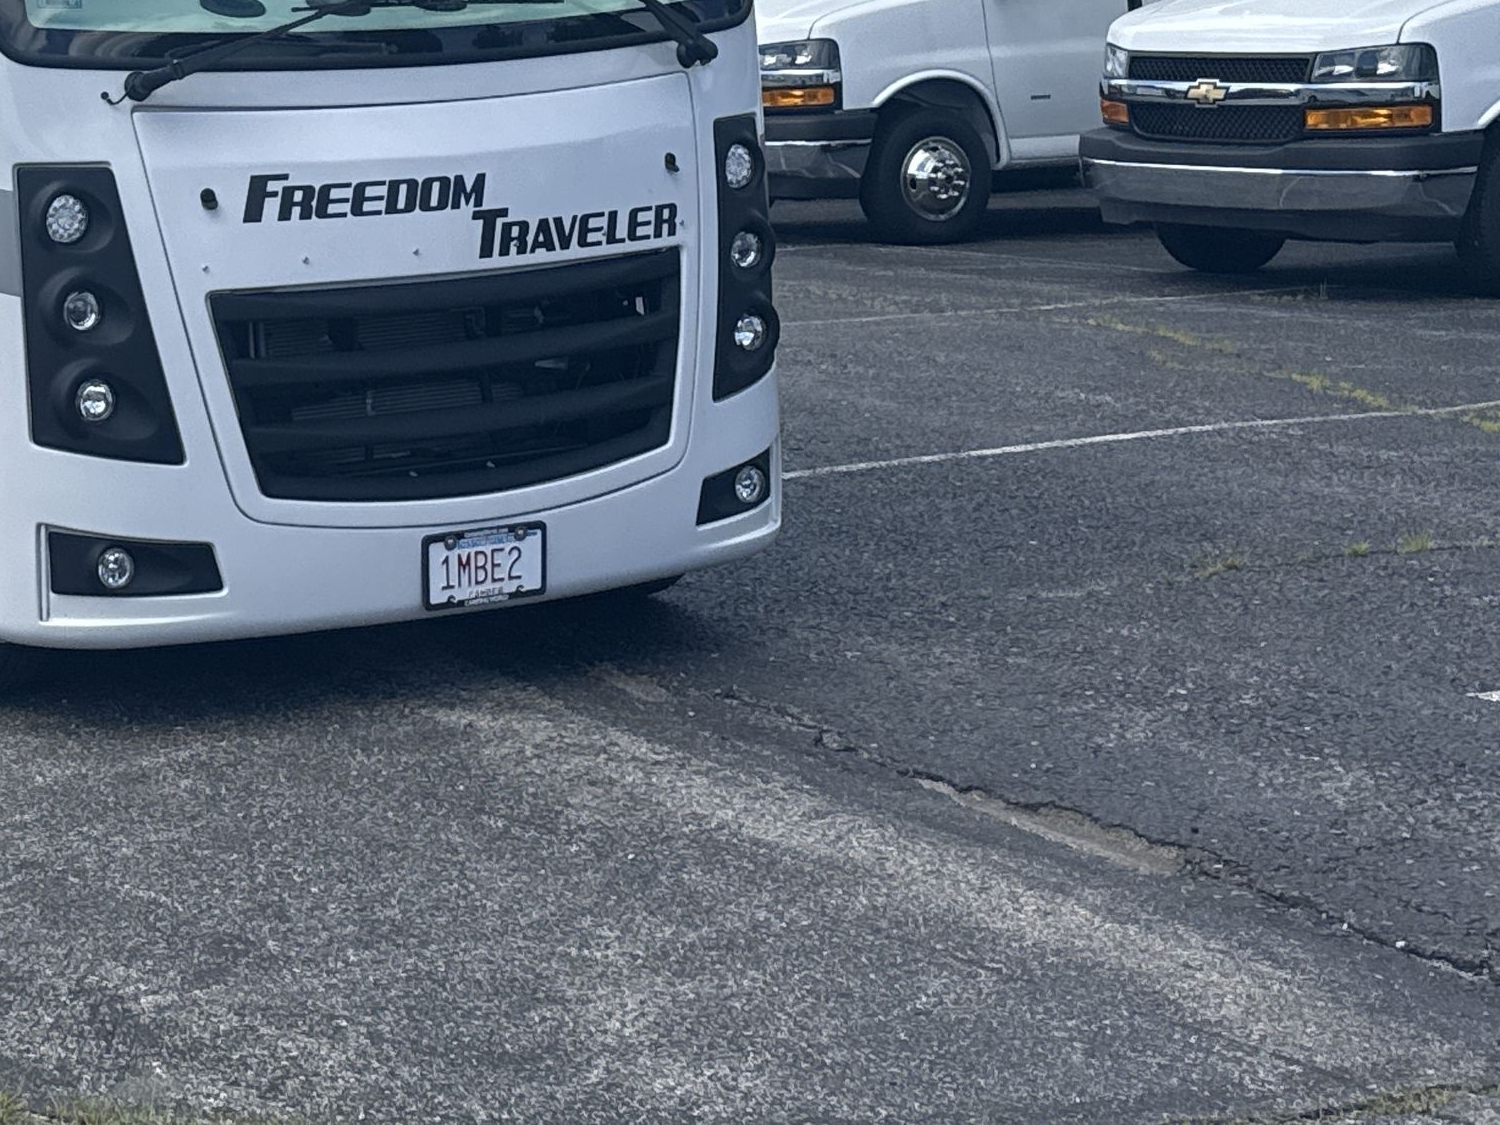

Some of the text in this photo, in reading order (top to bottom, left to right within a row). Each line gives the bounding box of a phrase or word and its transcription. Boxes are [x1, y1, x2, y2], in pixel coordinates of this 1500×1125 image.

[243, 173, 486, 223] FREEDOM
[471, 202, 678, 259] TRAVELER
[441, 546, 522, 591] 1MBE2
